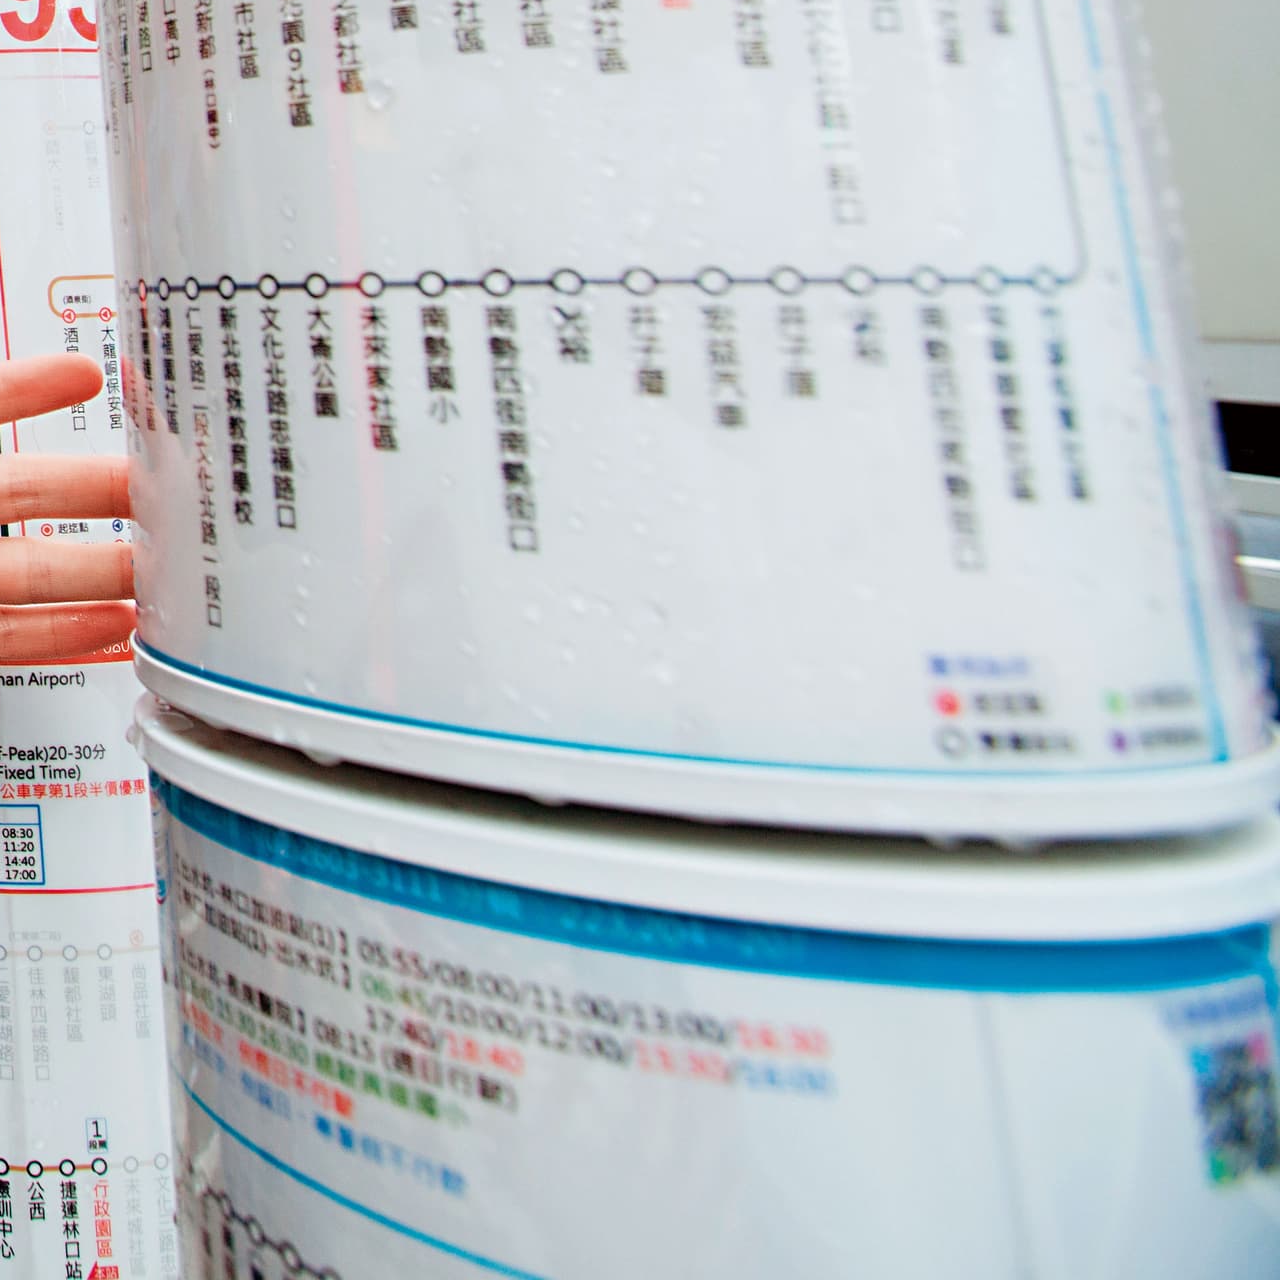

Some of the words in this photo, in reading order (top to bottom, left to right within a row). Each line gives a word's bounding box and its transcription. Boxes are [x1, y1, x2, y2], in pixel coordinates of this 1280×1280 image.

[28, 670, 85, 689] Airport)
[39, 765, 81, 782] Time)
[1, 827, 34, 839] 08:30
[3, 841, 35, 853] 11:20
[4, 855, 36, 867] 14:40
[5, 869, 37, 881] 17:00
[93, 1121, 102, 1138] 1
[27, 1181, 46, 1220] 公西
[93, 1180, 113, 1258] 行政園區
[60, 1180, 83, 1279] 捷運林口站
